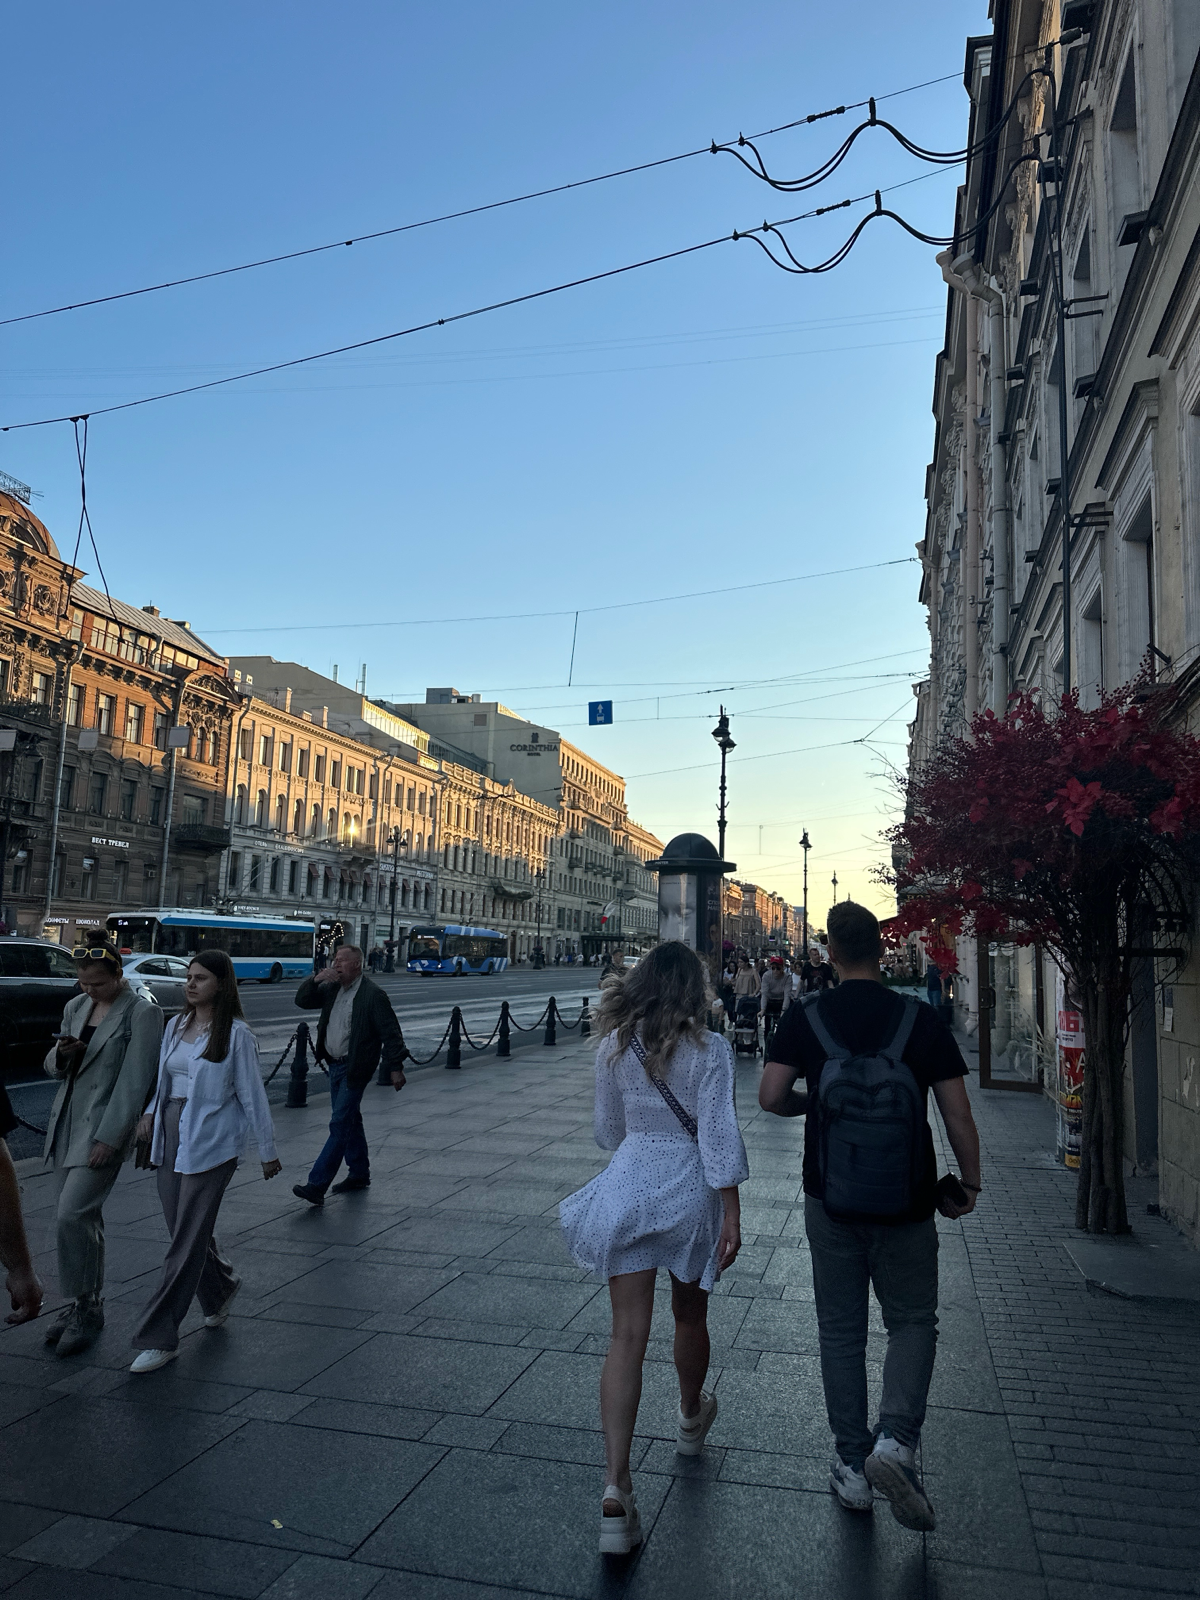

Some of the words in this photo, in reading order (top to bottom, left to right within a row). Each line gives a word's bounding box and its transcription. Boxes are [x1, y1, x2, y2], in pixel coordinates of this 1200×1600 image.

[91, 836, 106, 844] ВЕСТ
[108, 839, 129, 848] ТРЕВЕЛ
[75, 918, 100, 926] ШОКОЛАД
